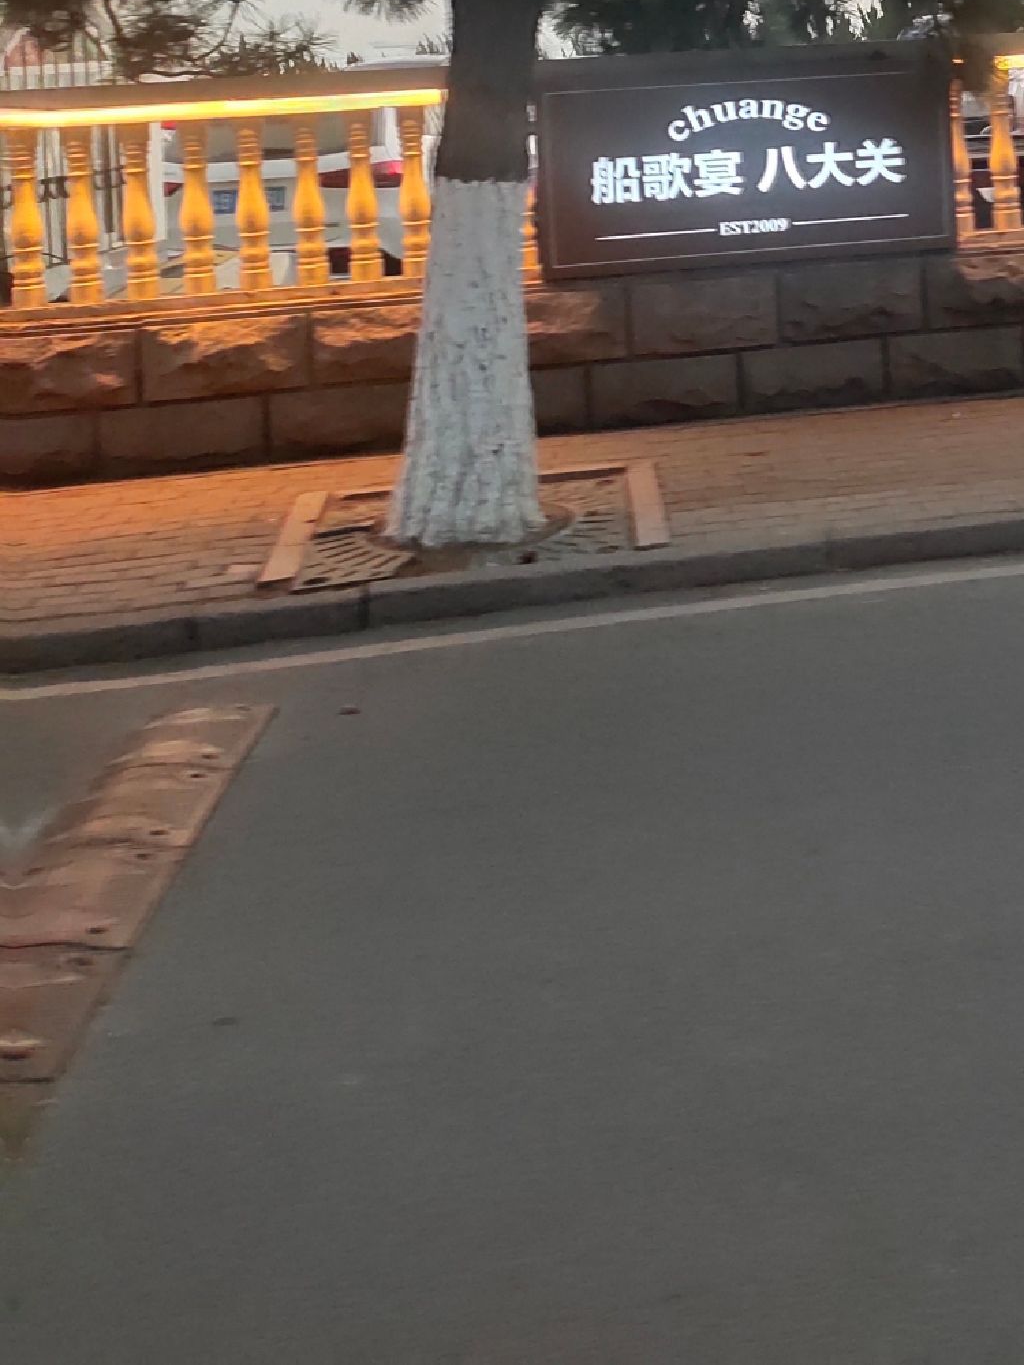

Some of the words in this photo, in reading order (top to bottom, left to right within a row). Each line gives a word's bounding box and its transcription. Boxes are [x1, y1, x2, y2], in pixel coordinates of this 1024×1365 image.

[667, 98, 831, 142] chuange
[590, 149, 744, 205] 船歌宴
[757, 138, 906, 193] 八大关
